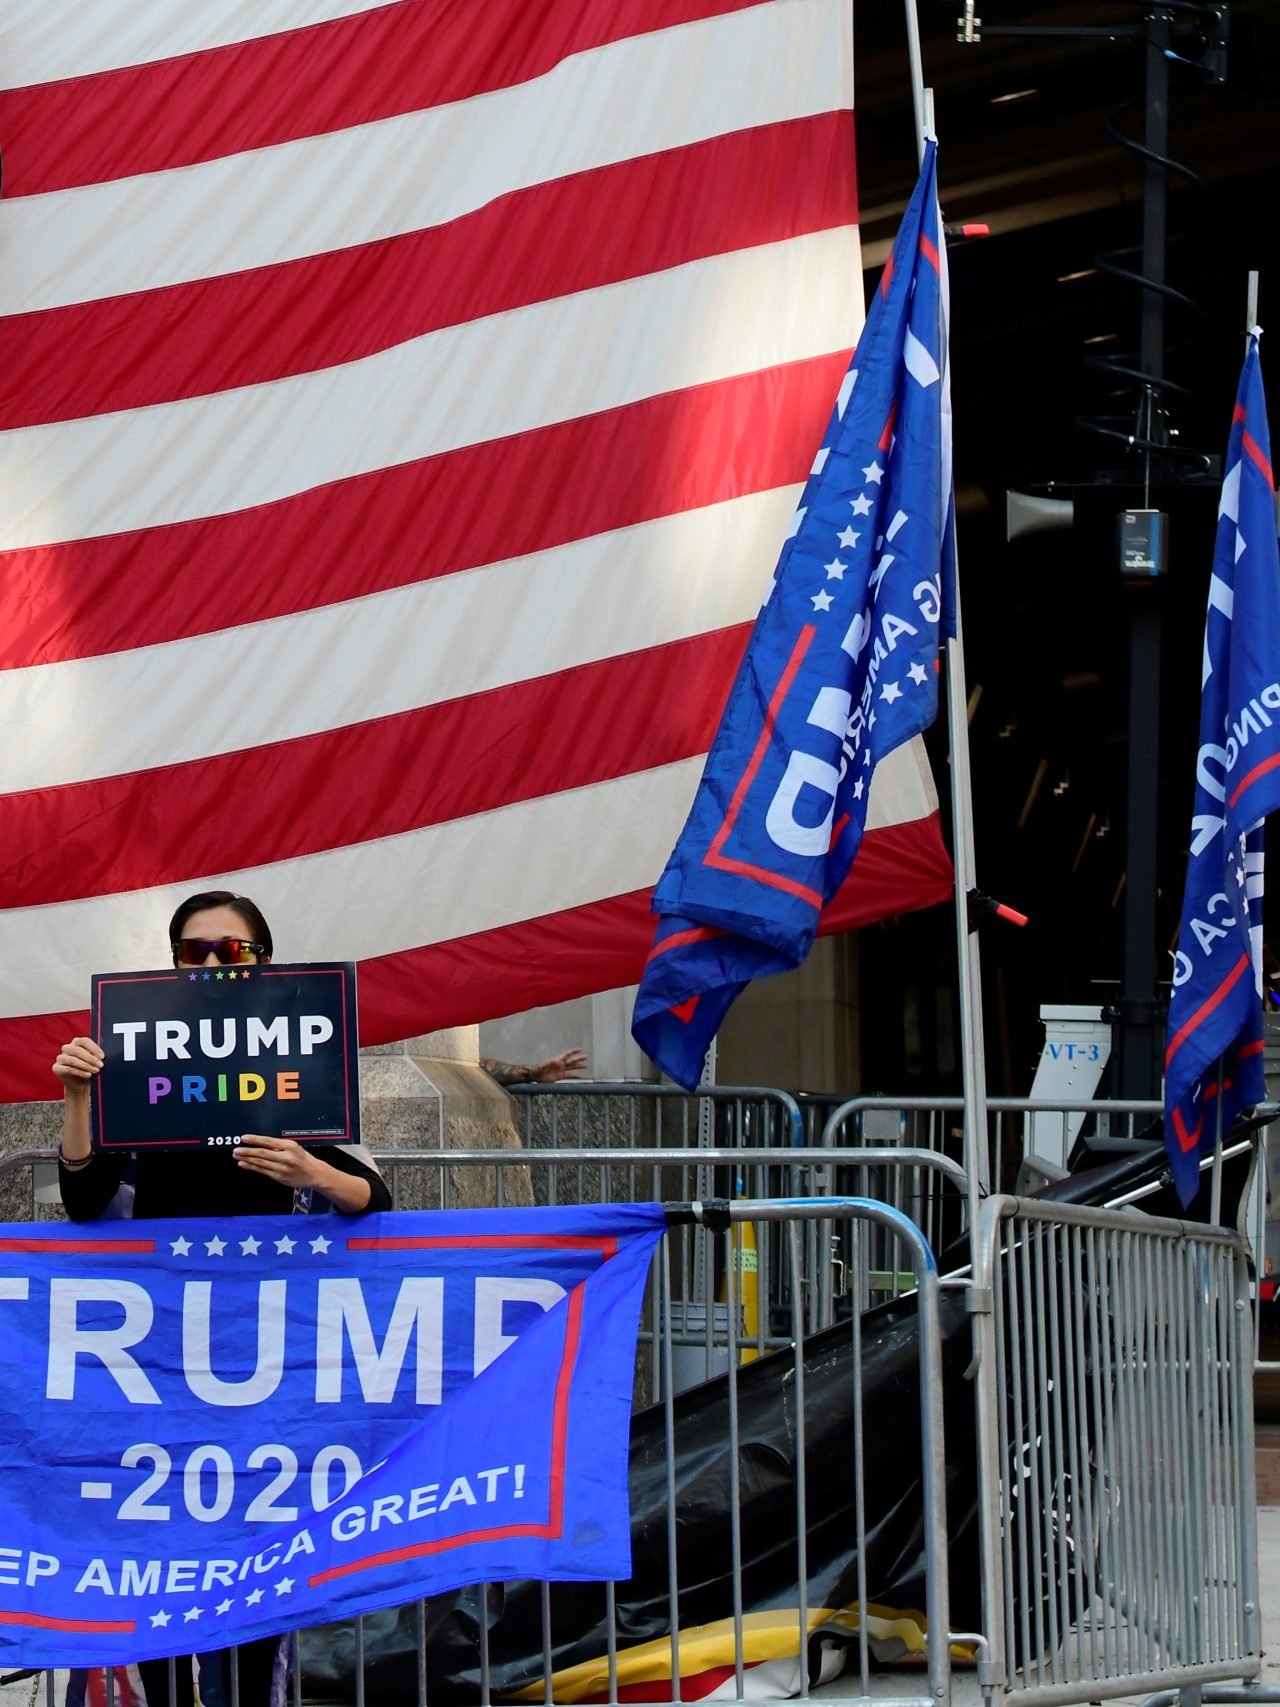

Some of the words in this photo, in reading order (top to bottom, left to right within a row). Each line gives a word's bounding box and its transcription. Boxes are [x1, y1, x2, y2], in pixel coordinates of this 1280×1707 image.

[113, 1015, 333, 1061] TRUMP
[1049, 1043, 1099, 1061] VT-3
[148, 1072, 300, 1104] PRIDE
[207, 1135, 242, 1146] 2020
[81, 1443, 388, 1523] -2020
[74, 1529, 316, 1597] AMERICA
[331, 1464, 525, 1542] GREAT!
